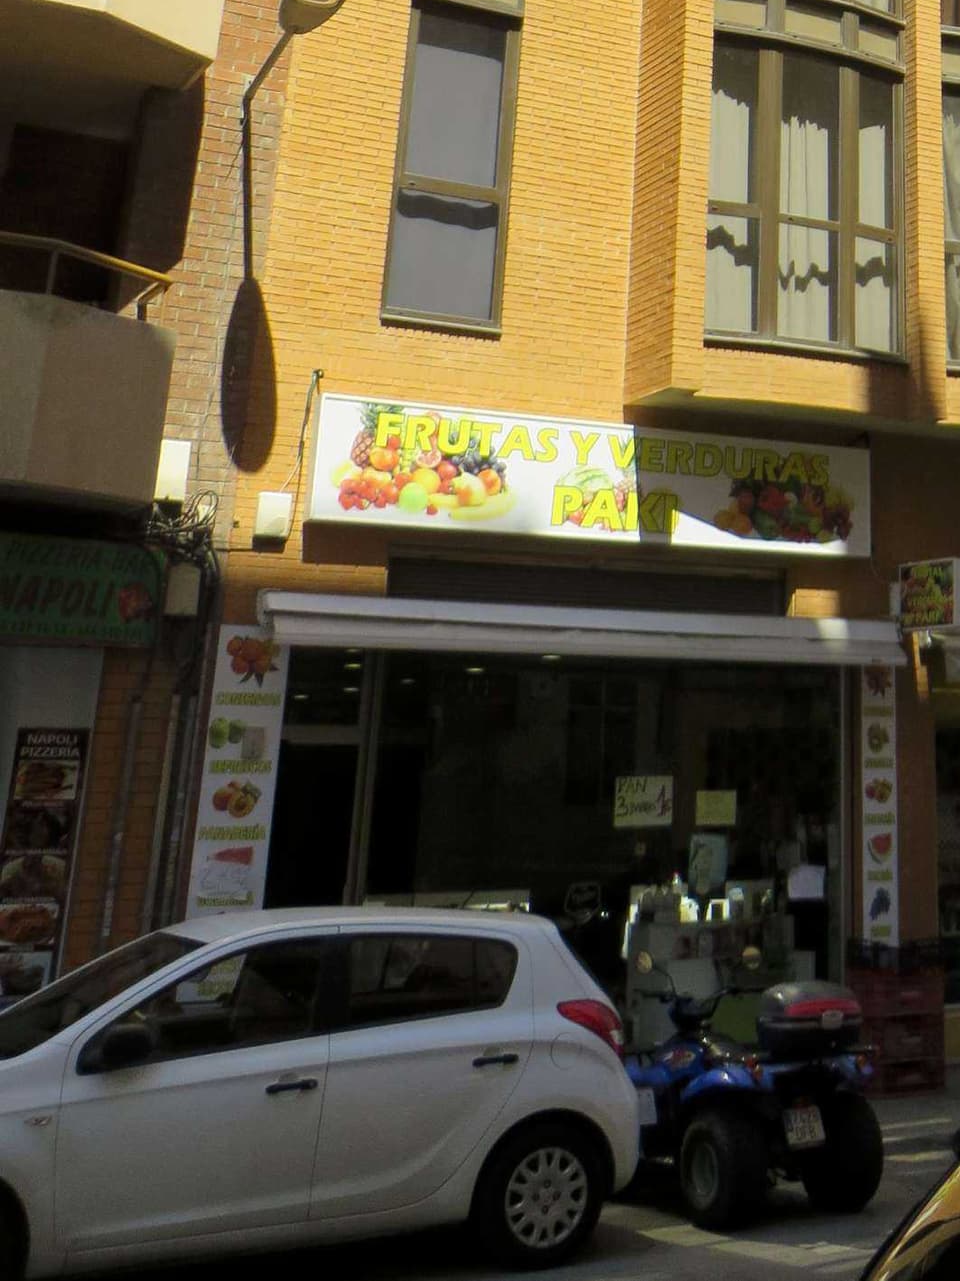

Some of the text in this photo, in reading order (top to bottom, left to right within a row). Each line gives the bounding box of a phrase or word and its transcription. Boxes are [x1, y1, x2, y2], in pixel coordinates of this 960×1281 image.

[375, 412, 829, 483] FRUTAS Y VERDURAS
[551, 486, 680, 533] PAKI
[26, 733, 78, 745] NAPOLI
